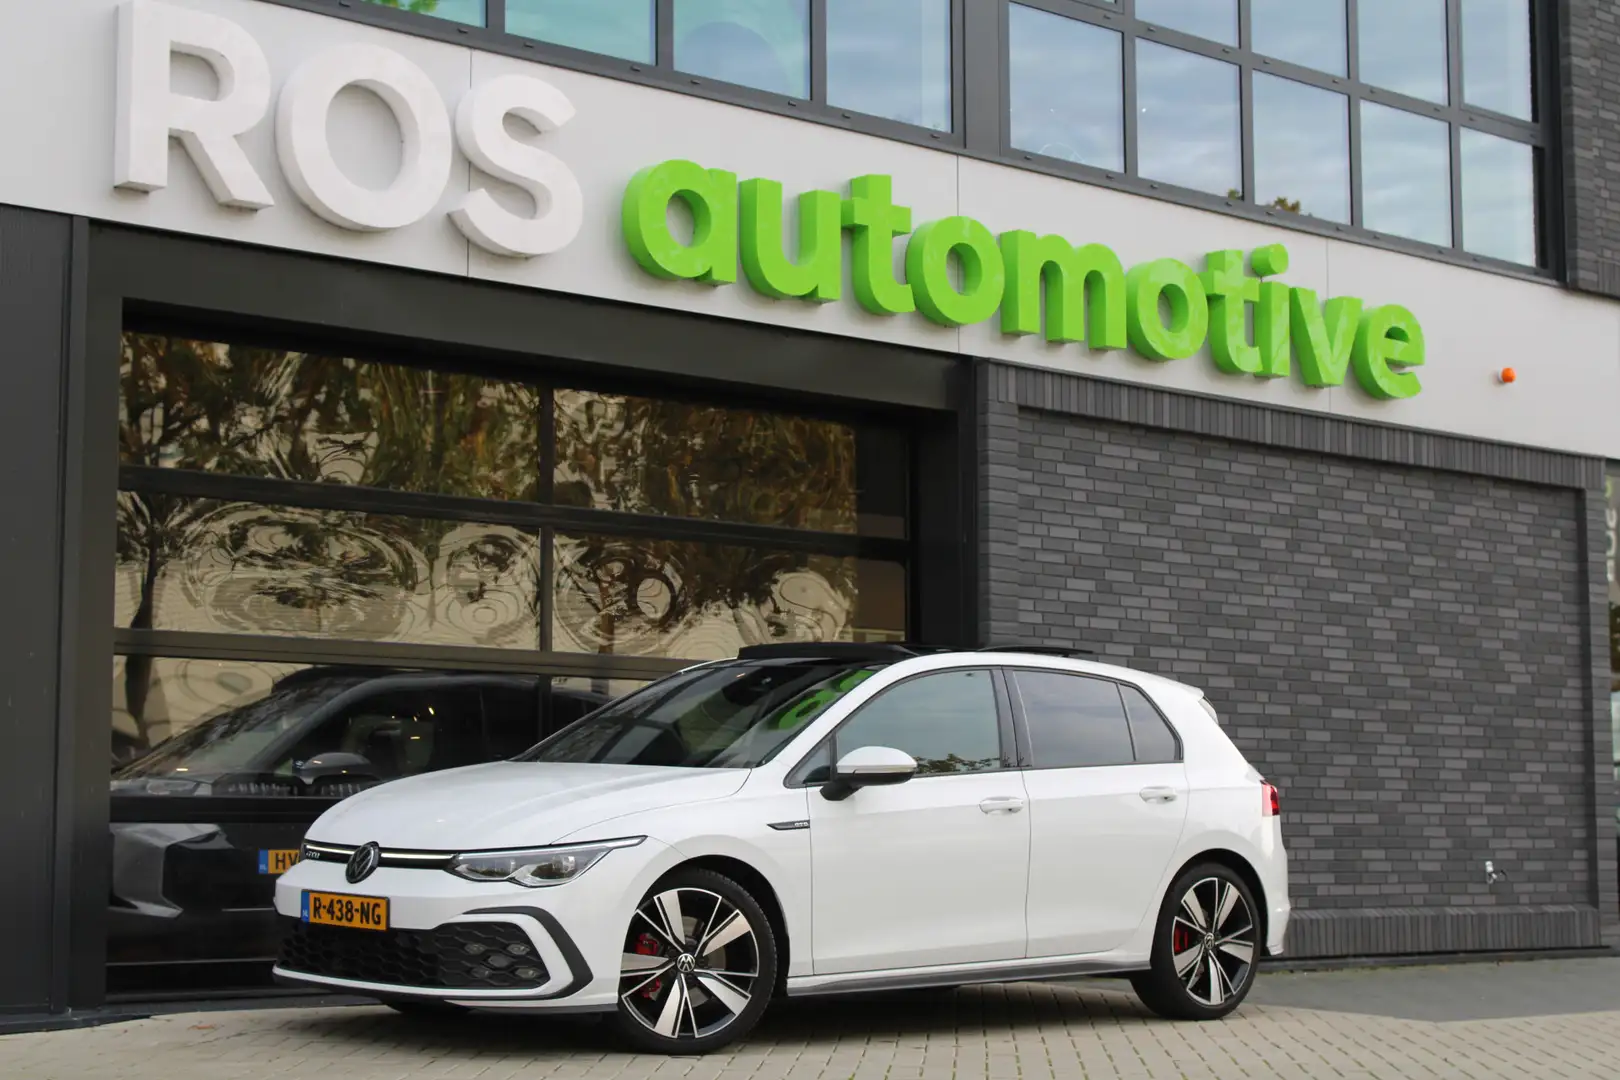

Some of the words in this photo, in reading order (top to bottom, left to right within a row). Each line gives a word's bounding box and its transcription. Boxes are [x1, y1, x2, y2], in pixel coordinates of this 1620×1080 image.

[113, 1, 583, 260] ROS
[622, 158, 1426, 400] automotive
[313, 896, 382, 926] R-438-NG
